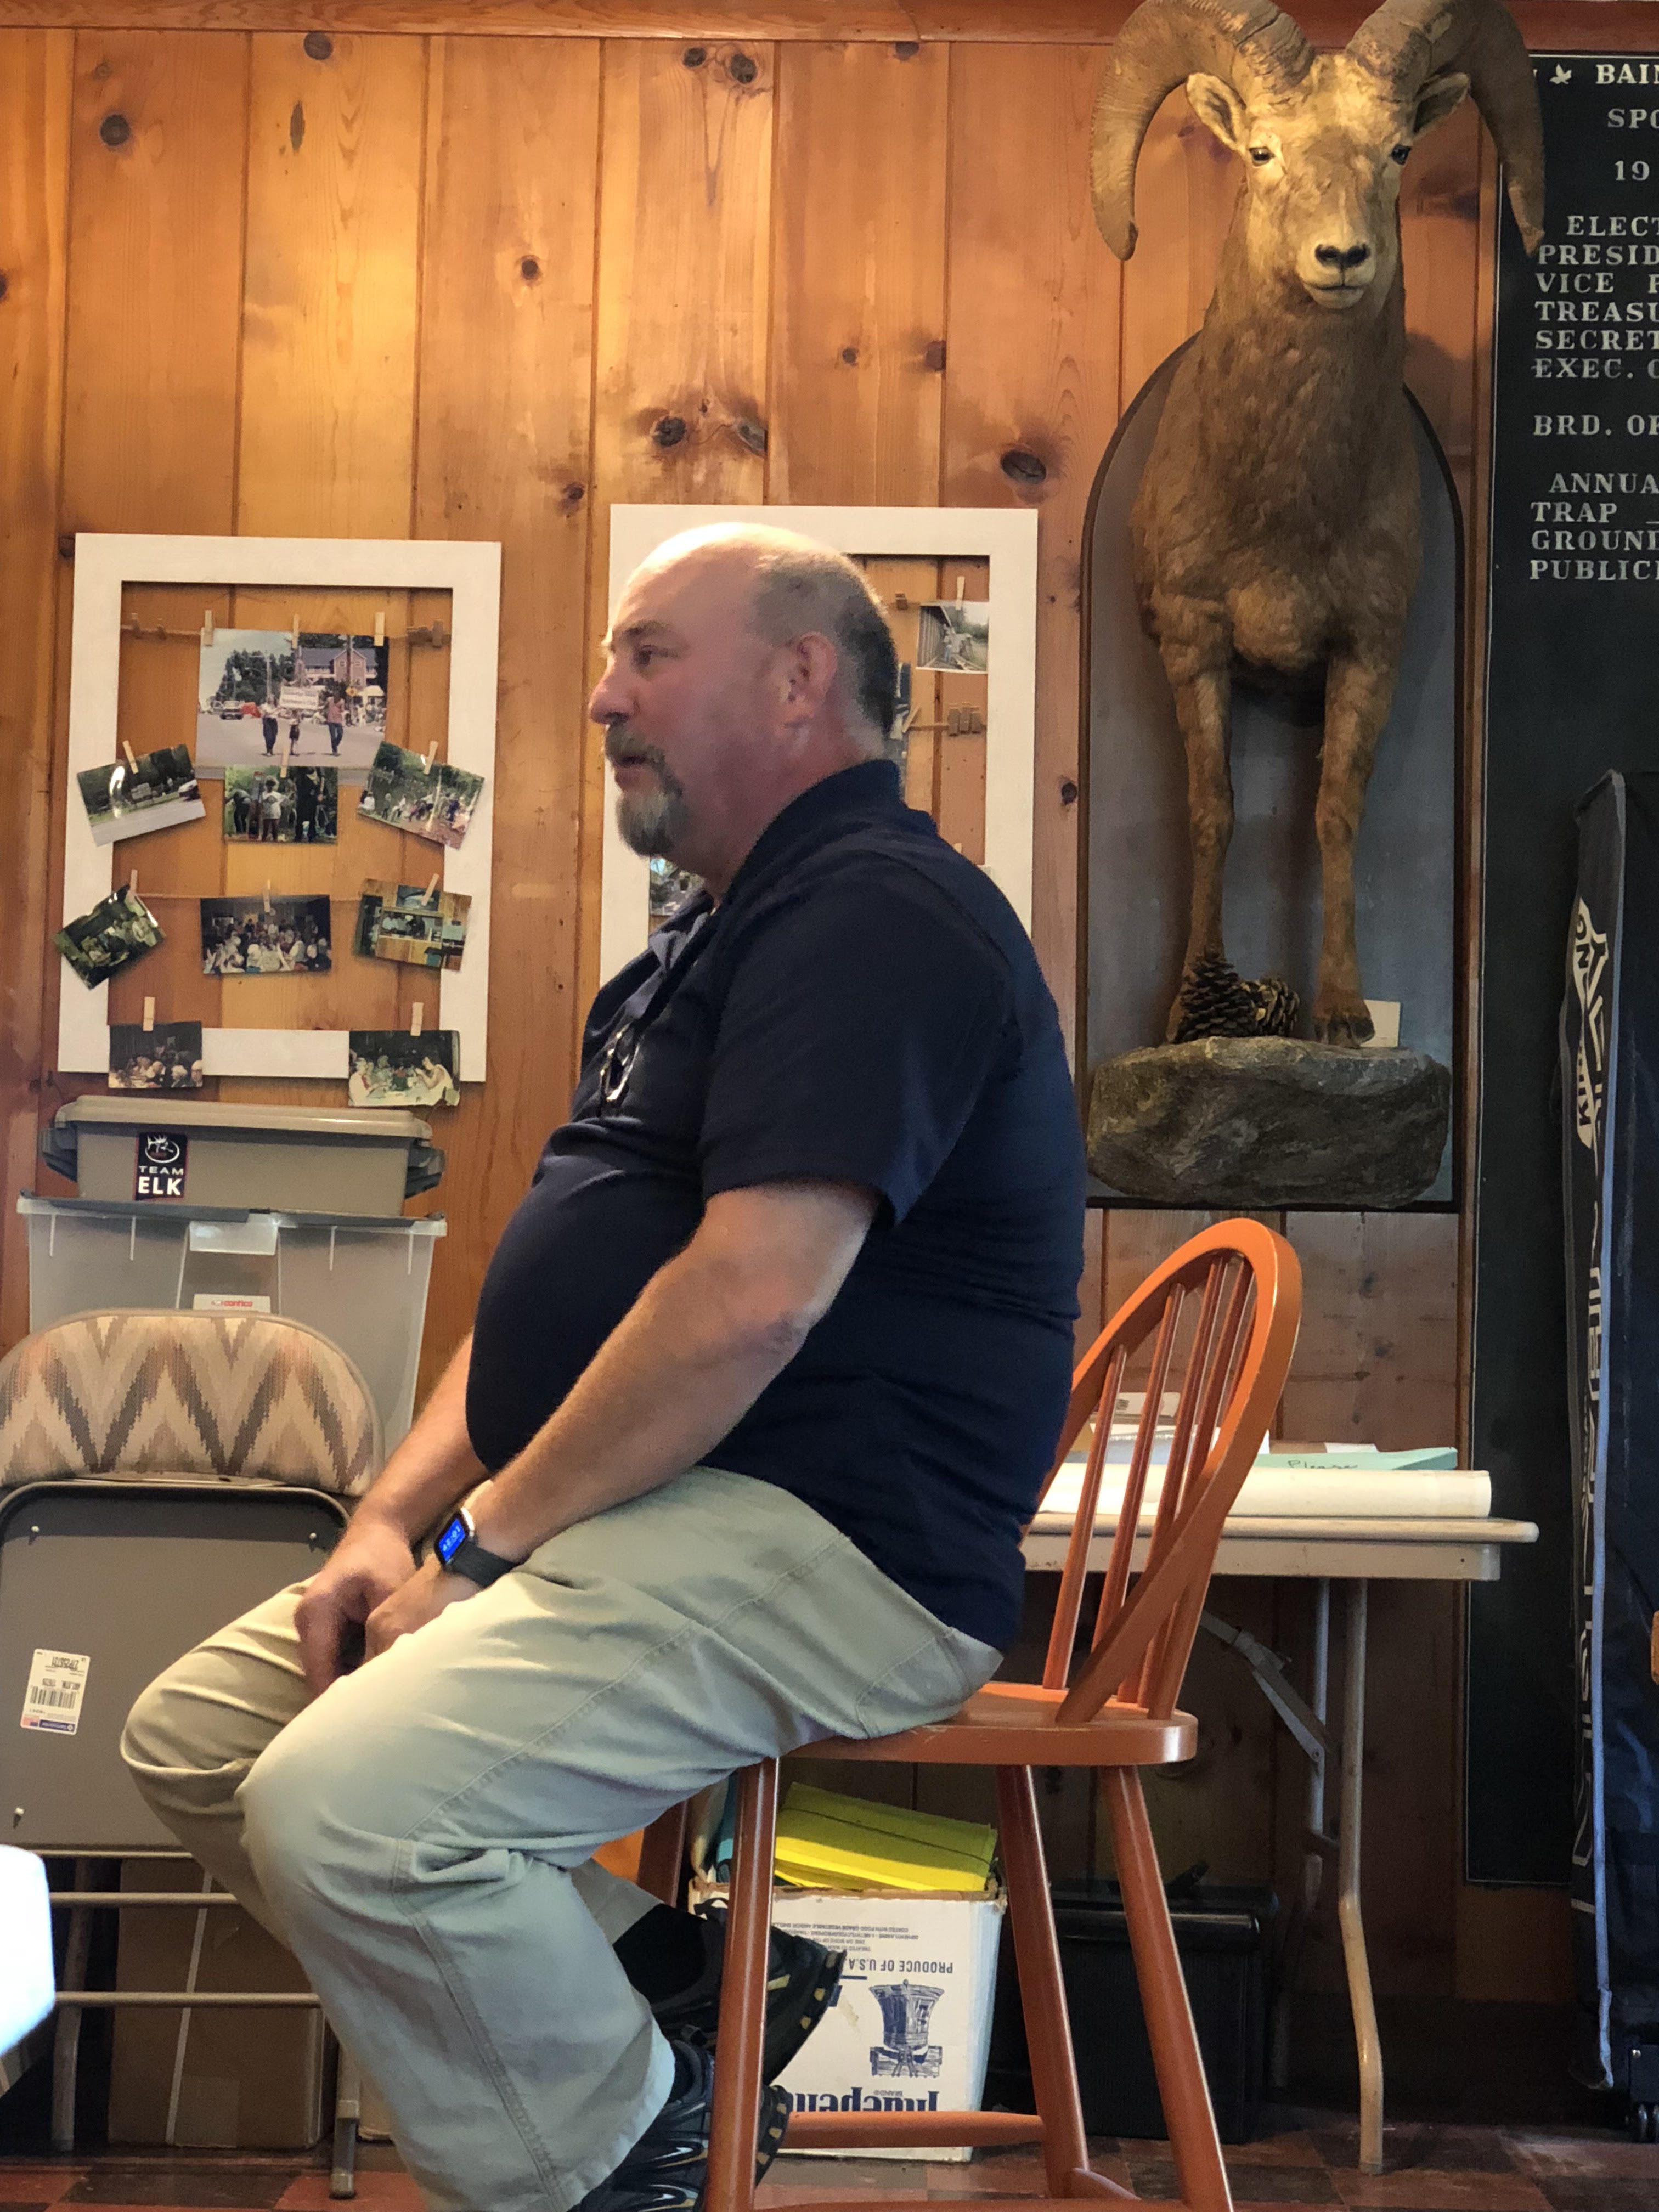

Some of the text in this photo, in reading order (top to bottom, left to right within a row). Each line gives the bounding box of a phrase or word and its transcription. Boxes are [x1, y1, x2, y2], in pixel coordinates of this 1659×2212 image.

[1595, 64, 1659, 84] BAI
[1615, 160, 1650, 181] 19
[1538, 245, 1659, 265] PRESID
[1536, 273, 1614, 293] VICE
[1534, 358, 1633, 379] EXEC.
[1533, 415, 1612, 436] BRD.
[1549, 473, 1659, 493] ANNUA
[1531, 502, 1617, 522] TRAP
[139, 1165, 184, 1175] TEAM
[138, 1176, 182, 1195] ELK
[880, 1960, 895, 1971] OF
[899, 1960, 953, 1974] PRODUCE
